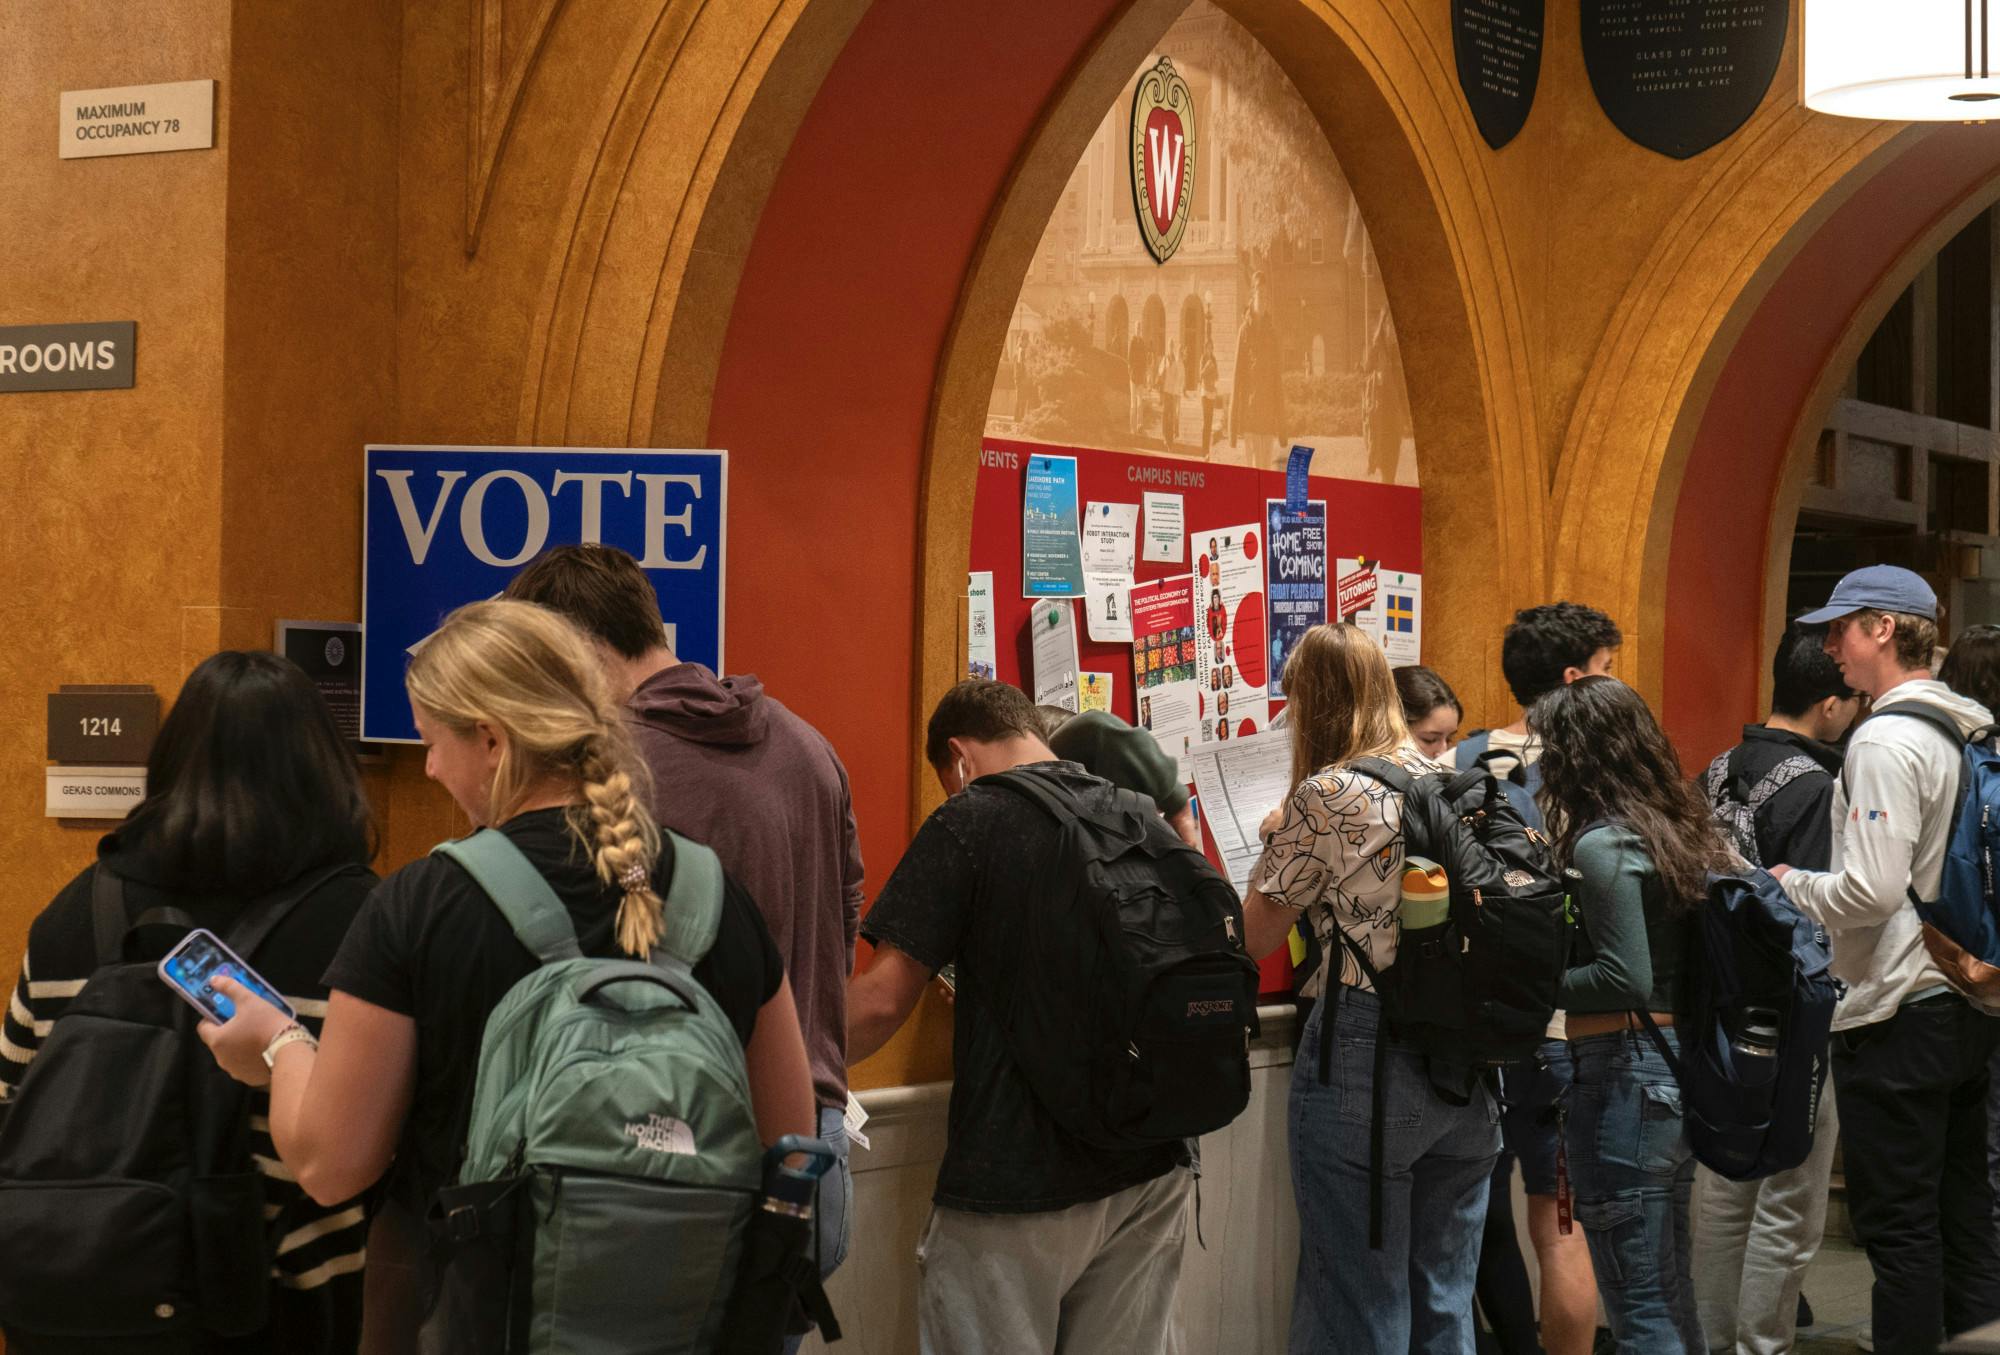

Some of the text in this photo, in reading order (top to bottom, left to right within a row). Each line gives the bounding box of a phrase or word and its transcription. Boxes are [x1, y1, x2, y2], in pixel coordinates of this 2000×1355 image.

[1636, 50, 1672, 60] CLASS
[1680, 48, 1693, 57] OF
[1632, 70, 1668, 79] SAMUEL
[76, 101, 146, 121] MAXIMUM
[76, 119, 181, 141] OCCUPANCY 78
[1149, 124, 1184, 222] W
[0, 340, 116, 374] ROOMS
[1053, 476, 1065, 484] PATH
[1127, 465, 1205, 488] CAMPUS NEWS
[376, 469, 708, 571] VOTE
[1086, 529, 1130, 539] ROBOT INTERACTION
[1100, 537, 1115, 545] STUDY
[1302, 527, 1321, 540] FREE
[1272, 532, 1302, 557] HOME
[1279, 554, 1323, 581] COMING
[1160, 590, 1181, 600] ECONOMY
[1181, 588, 1188, 596] OF
[1269, 583, 1289, 599] FRIDAY
[1290, 583, 1309, 599] PILOTS
[1340, 576, 1376, 604] TUTORING
[1043, 685, 1058, 697] Contact
[80, 717, 122, 736] 1214
[62, 785, 141, 797] GEKAS COMMONS
[649, 1113, 675, 1129] THE
[624, 1122, 673, 1141] NORTH
